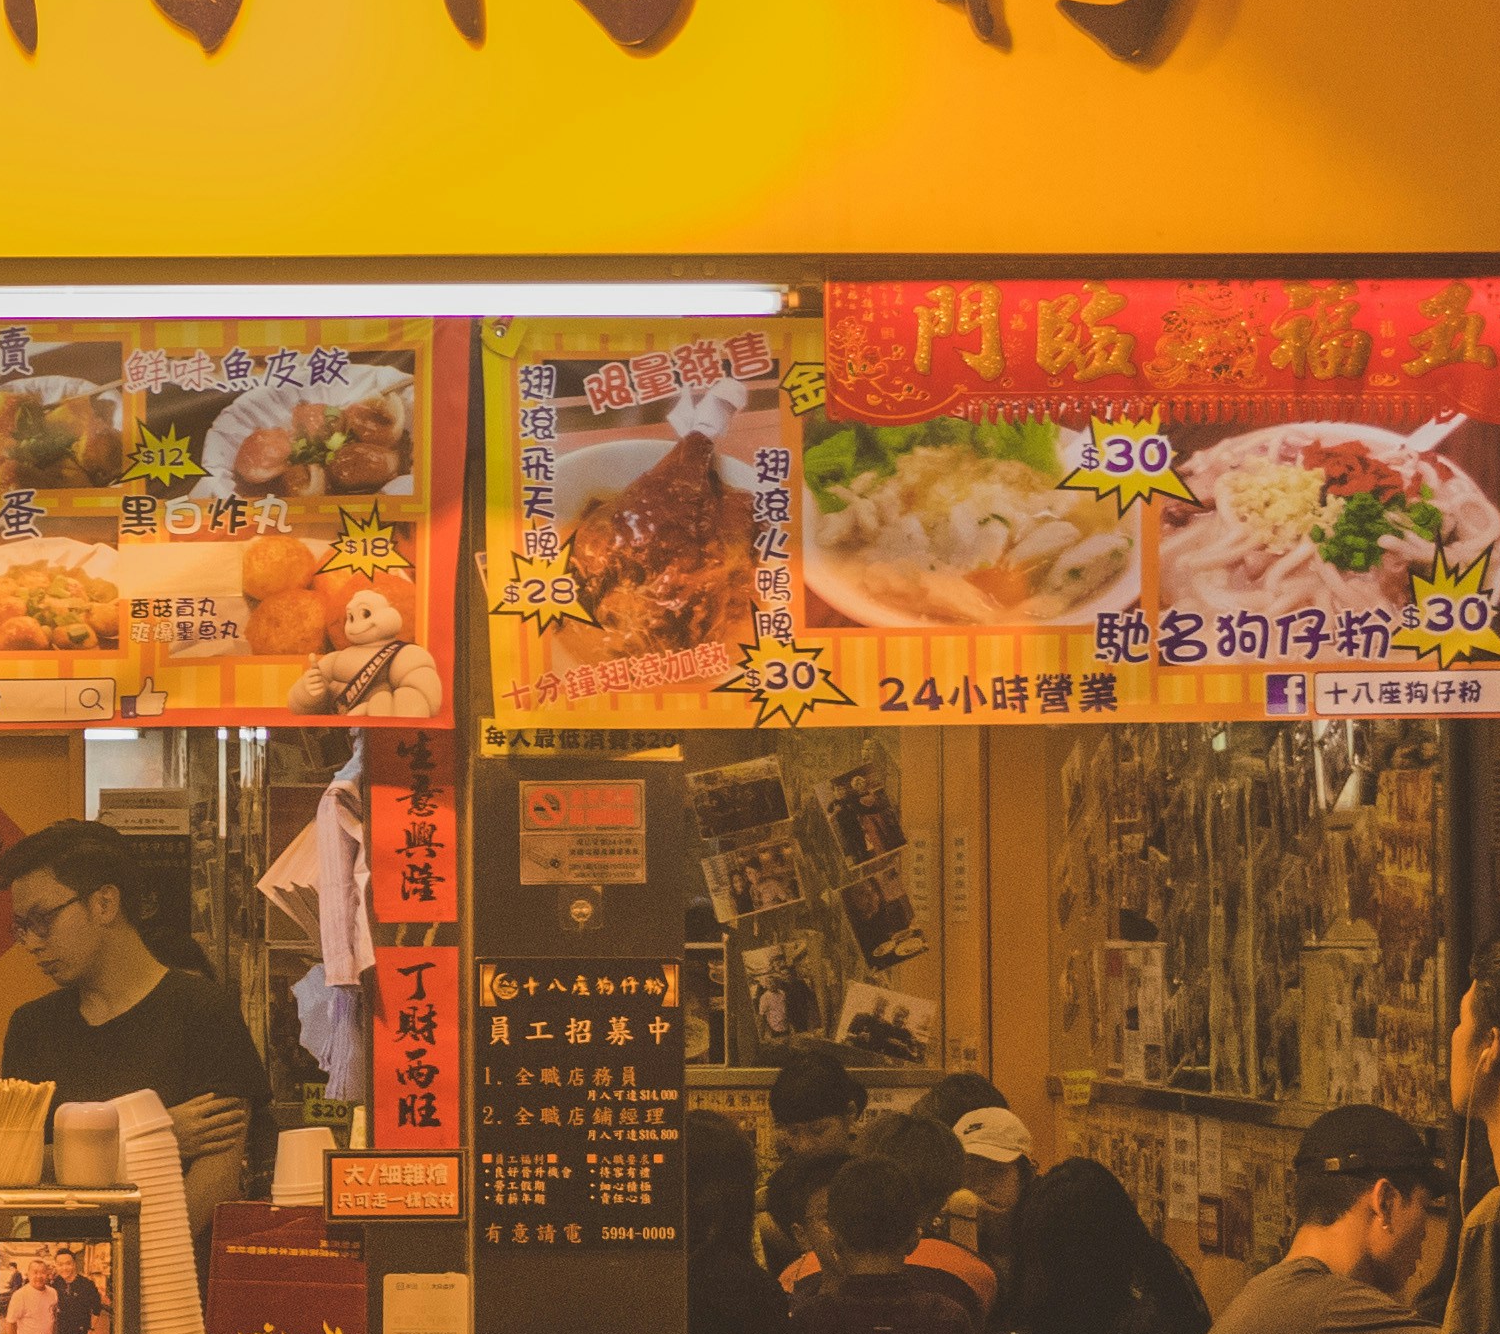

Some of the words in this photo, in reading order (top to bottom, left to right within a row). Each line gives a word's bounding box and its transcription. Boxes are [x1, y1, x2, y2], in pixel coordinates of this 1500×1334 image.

[124, 346, 350, 391] 鮮味魚皮餃
[585, 332, 774, 414] 限量發售
[141, 447, 184, 468] $12
[1080, 436, 1170, 474] $30
[120, 494, 293, 536] 黑白炸丸
[344, 538, 391, 558] $18
[503, 577, 577, 605] $28
[130, 598, 218, 619] 香菇貢丸
[1401, 596, 1489, 632] $30
[1093, 609, 1392, 664] 馳名狗仔粉
[345, 644, 402, 704] MICHELIN
[744, 659, 815, 691] $30
[878, 672, 1119, 715] 24小時營業
[1325, 680, 1483, 705] 十八座狗仔粉
[397, 733, 445, 903] 生意興隆
[522, 974, 665, 997] 十八座狗仔粉
[489, 1015, 671, 1046] 員工招募中
[514, 1066, 638, 1088] 全職店務員
[311, 1102, 348, 1119] $20
[484, 1222, 583, 1244] 有意請電
[601, 1226, 676, 1241] 5994-0009
